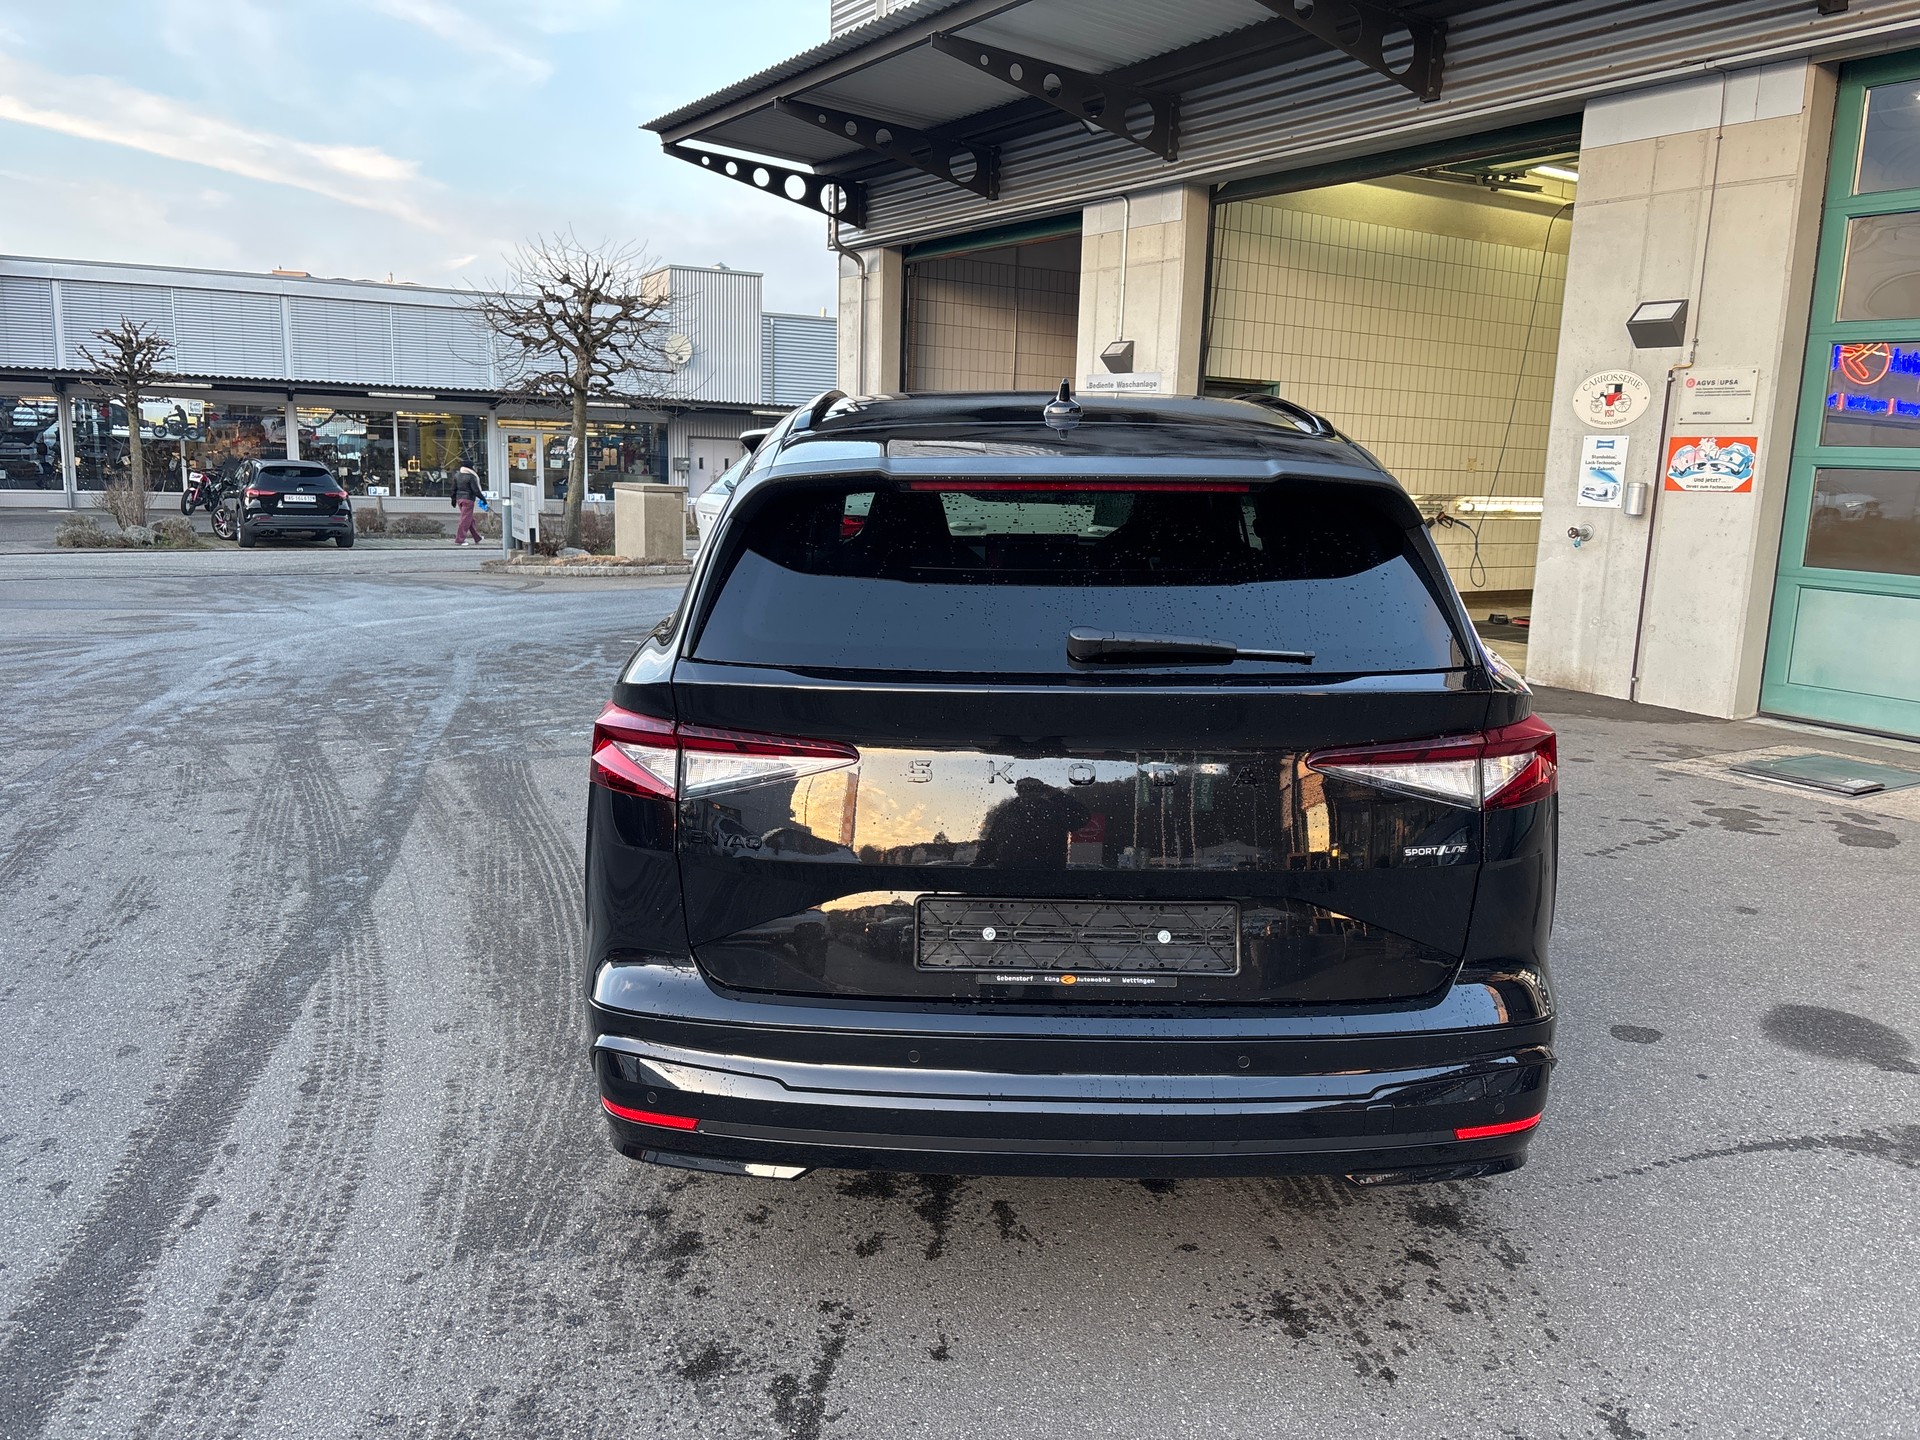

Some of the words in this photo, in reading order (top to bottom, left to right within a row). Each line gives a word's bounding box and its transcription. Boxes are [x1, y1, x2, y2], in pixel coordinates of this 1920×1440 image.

[1116, 380, 1157, 389] Waschanlage
[1582, 373, 1643, 391] CARROSSERIE
[691, 829, 763, 851] ENYAQ
[996, 975, 1034, 983] Gebenstorf
[1044, 975, 1060, 984] Küng
[1122, 977, 1156, 985] Wettingen
